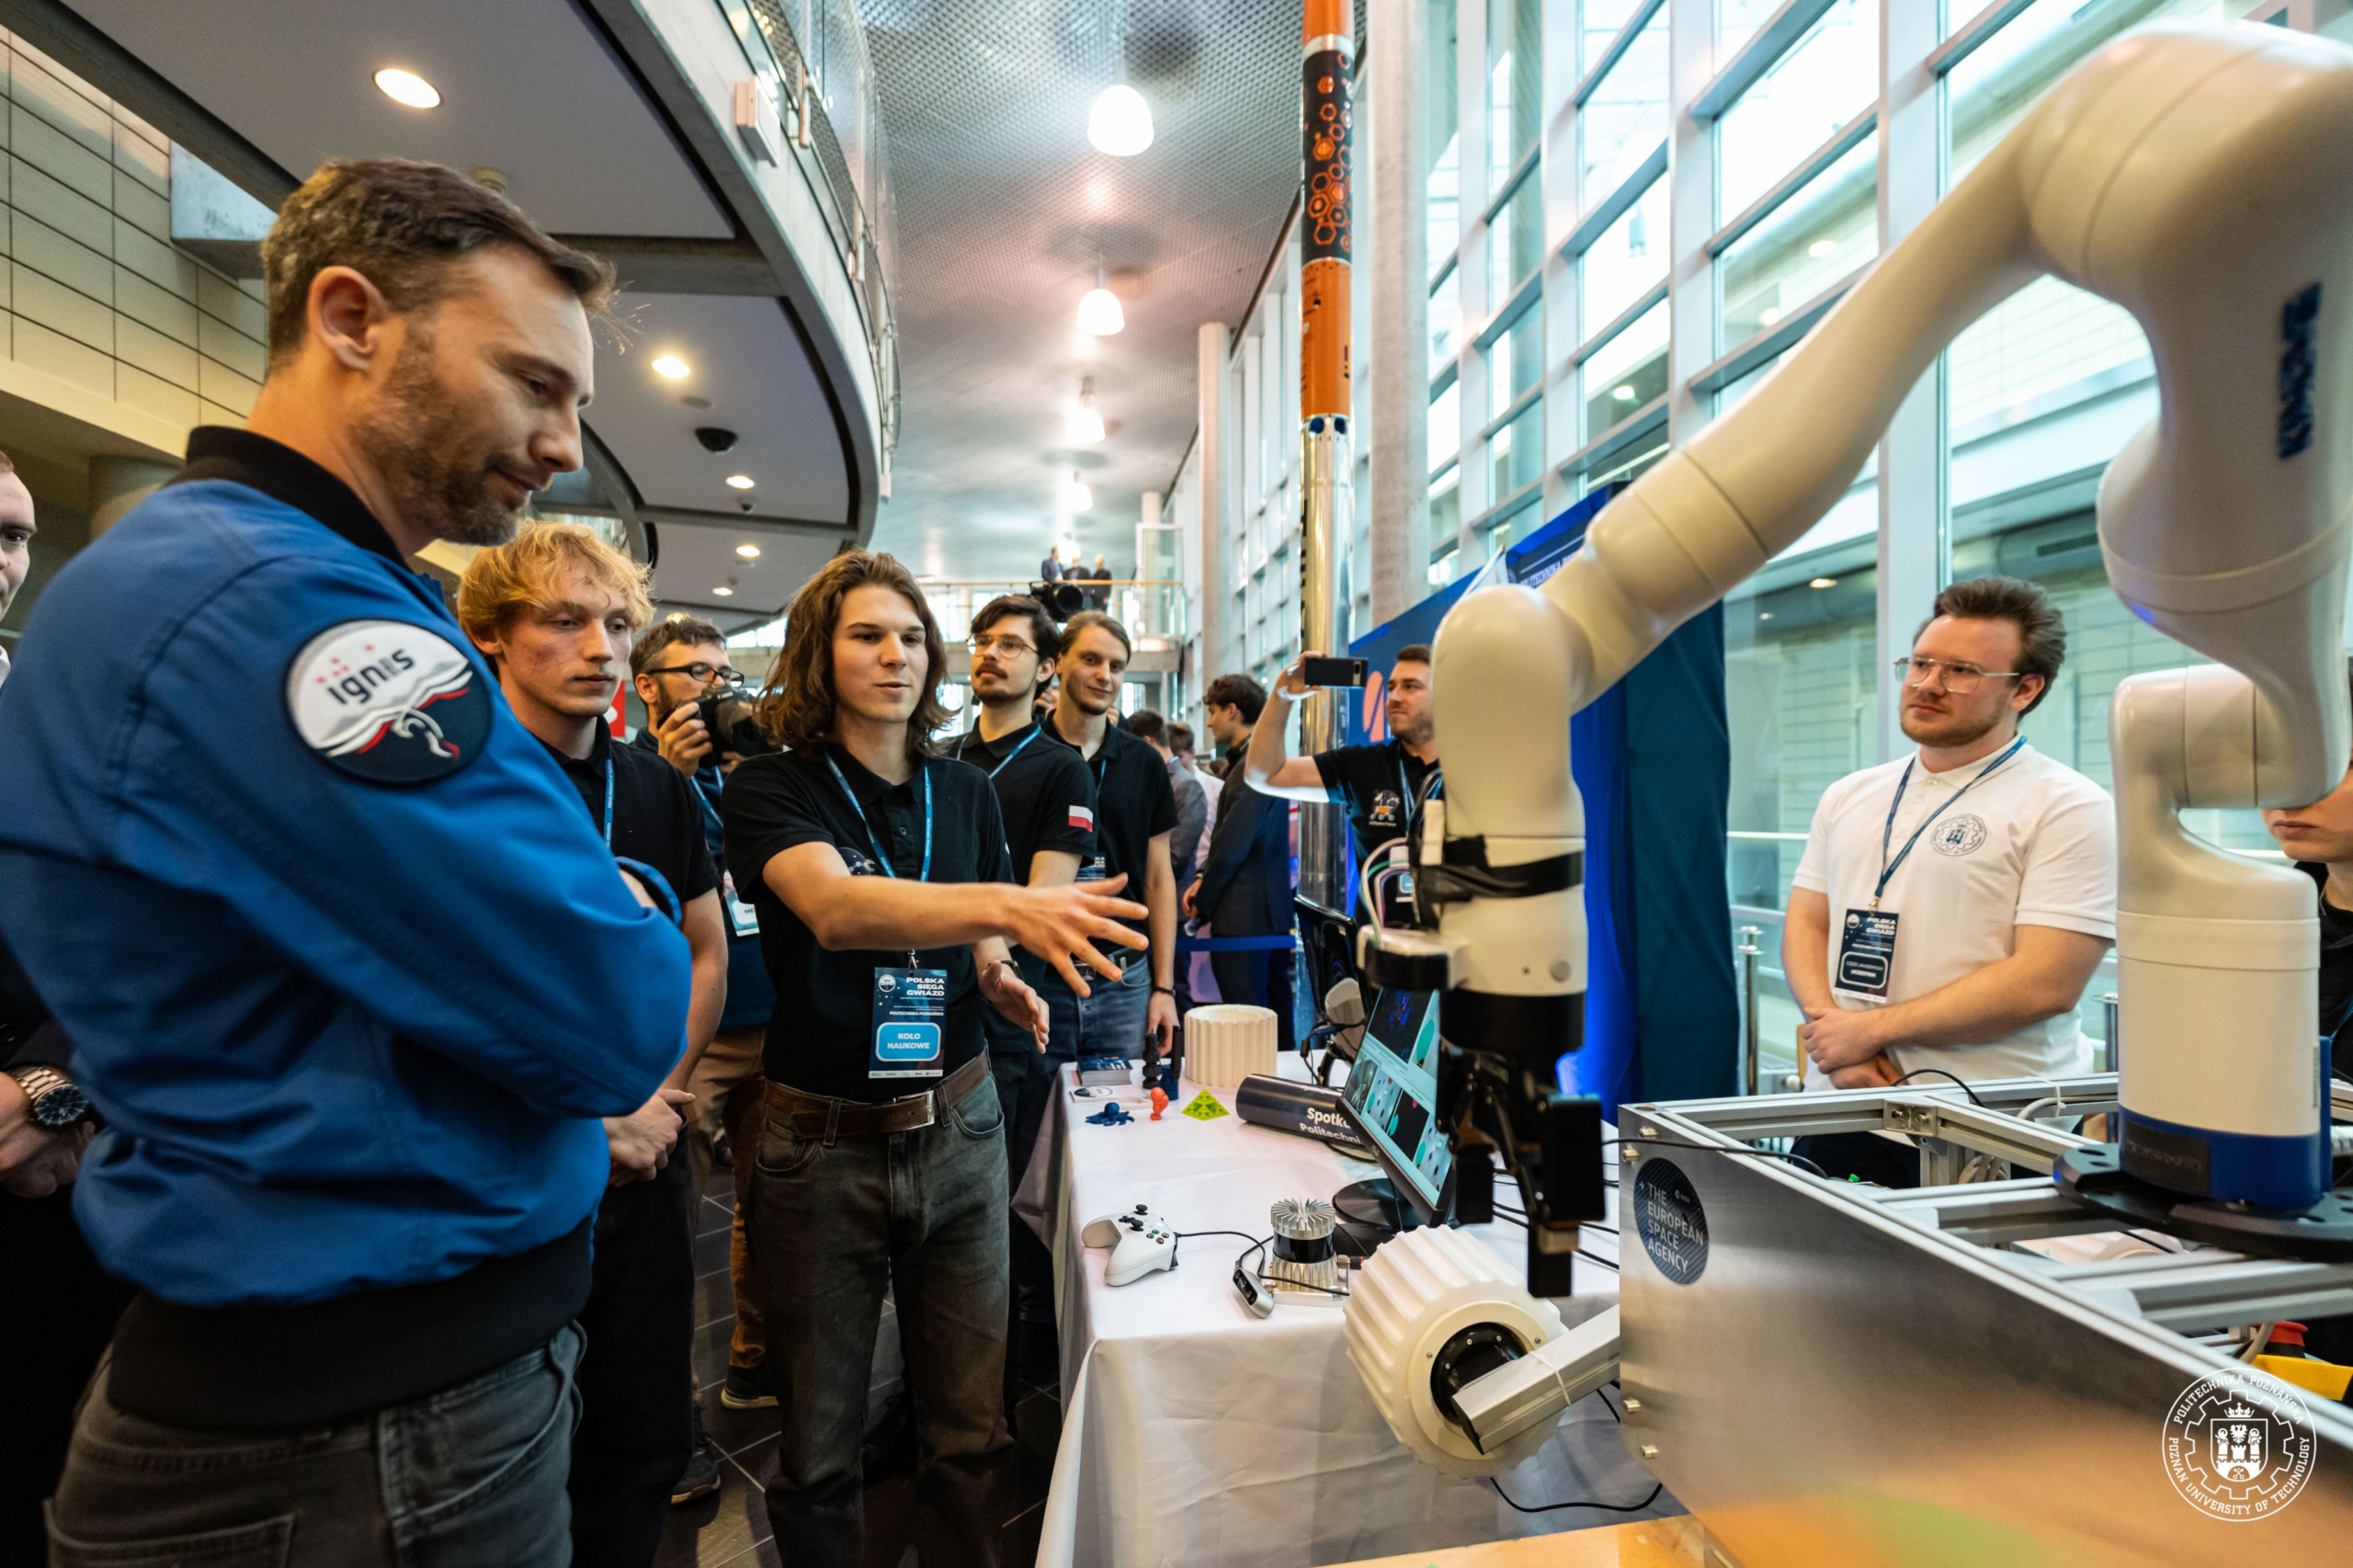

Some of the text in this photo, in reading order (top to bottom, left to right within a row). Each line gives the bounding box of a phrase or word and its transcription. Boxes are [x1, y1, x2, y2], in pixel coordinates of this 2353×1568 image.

[916, 983, 945, 992] SIĘGA
[1648, 1182, 1667, 1207] THE
[1647, 1200, 1704, 1247] EUROPEAN
[1647, 1219, 1679, 1251] SPACE
[1647, 1237, 1688, 1274] AGENCY
